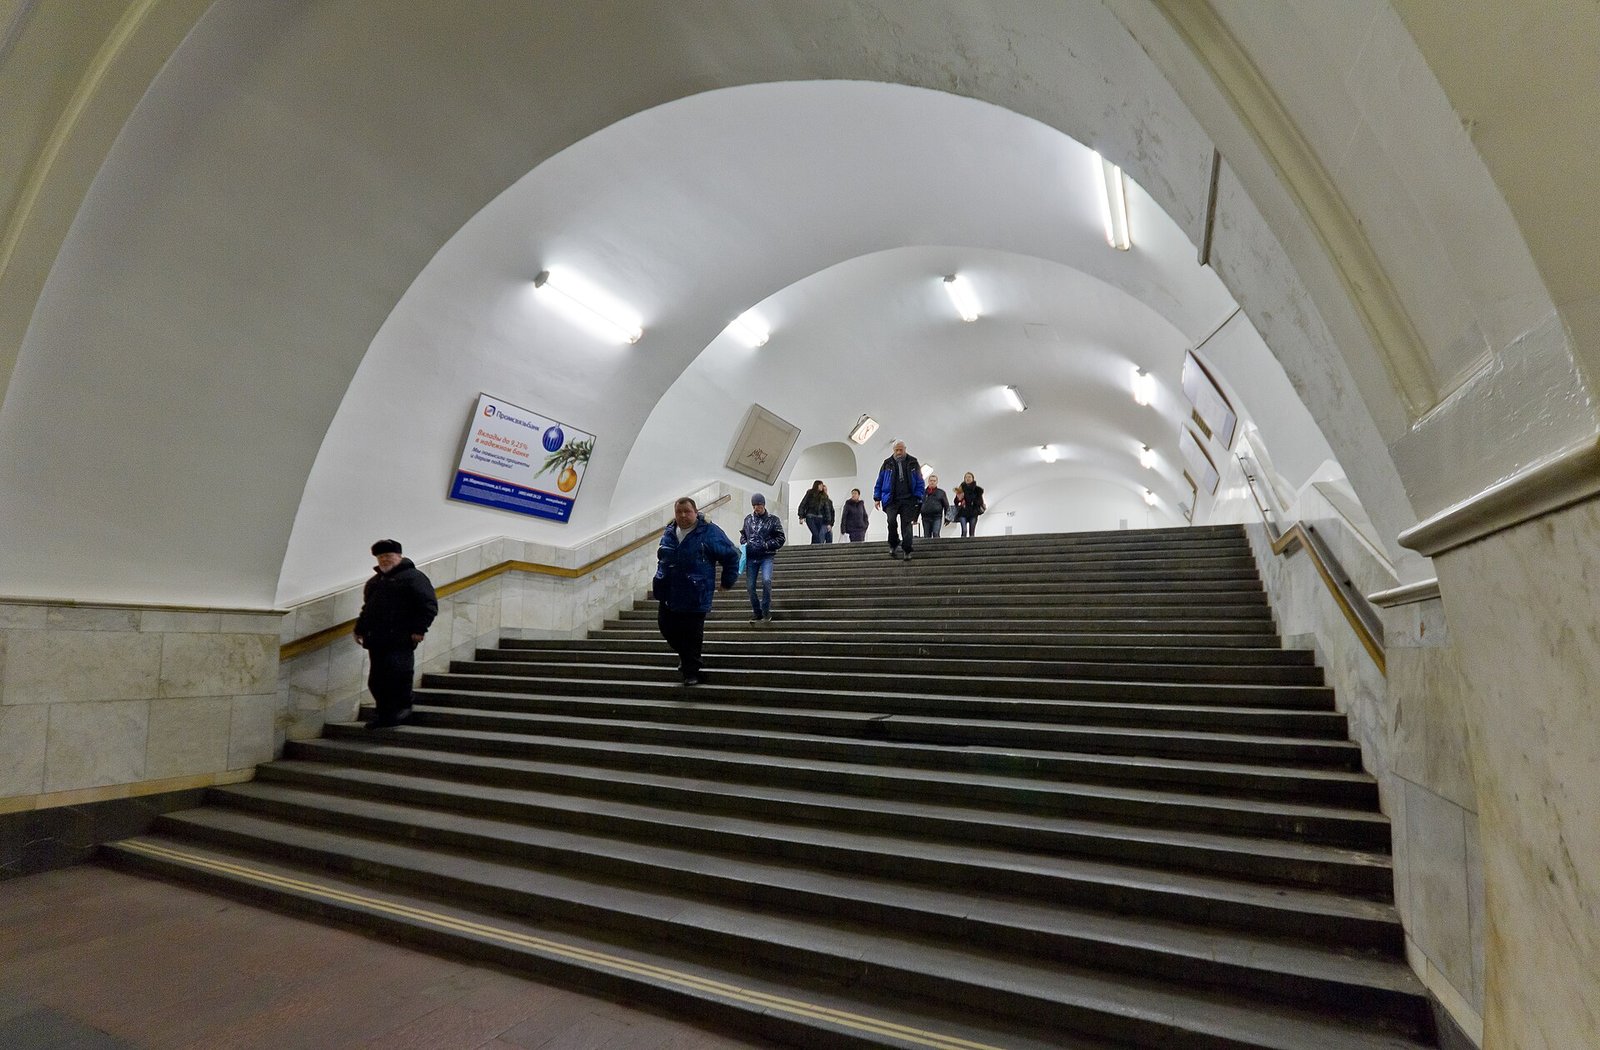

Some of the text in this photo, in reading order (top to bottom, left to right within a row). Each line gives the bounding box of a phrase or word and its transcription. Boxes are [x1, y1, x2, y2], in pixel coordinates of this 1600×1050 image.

[496, 410, 540, 431] Промсвязьбанк
[472, 446, 482, 454] Мы
[478, 429, 529, 451] Вклады до 9,25%
[479, 437, 512, 452] надежном
[512, 447, 529, 458] банке
